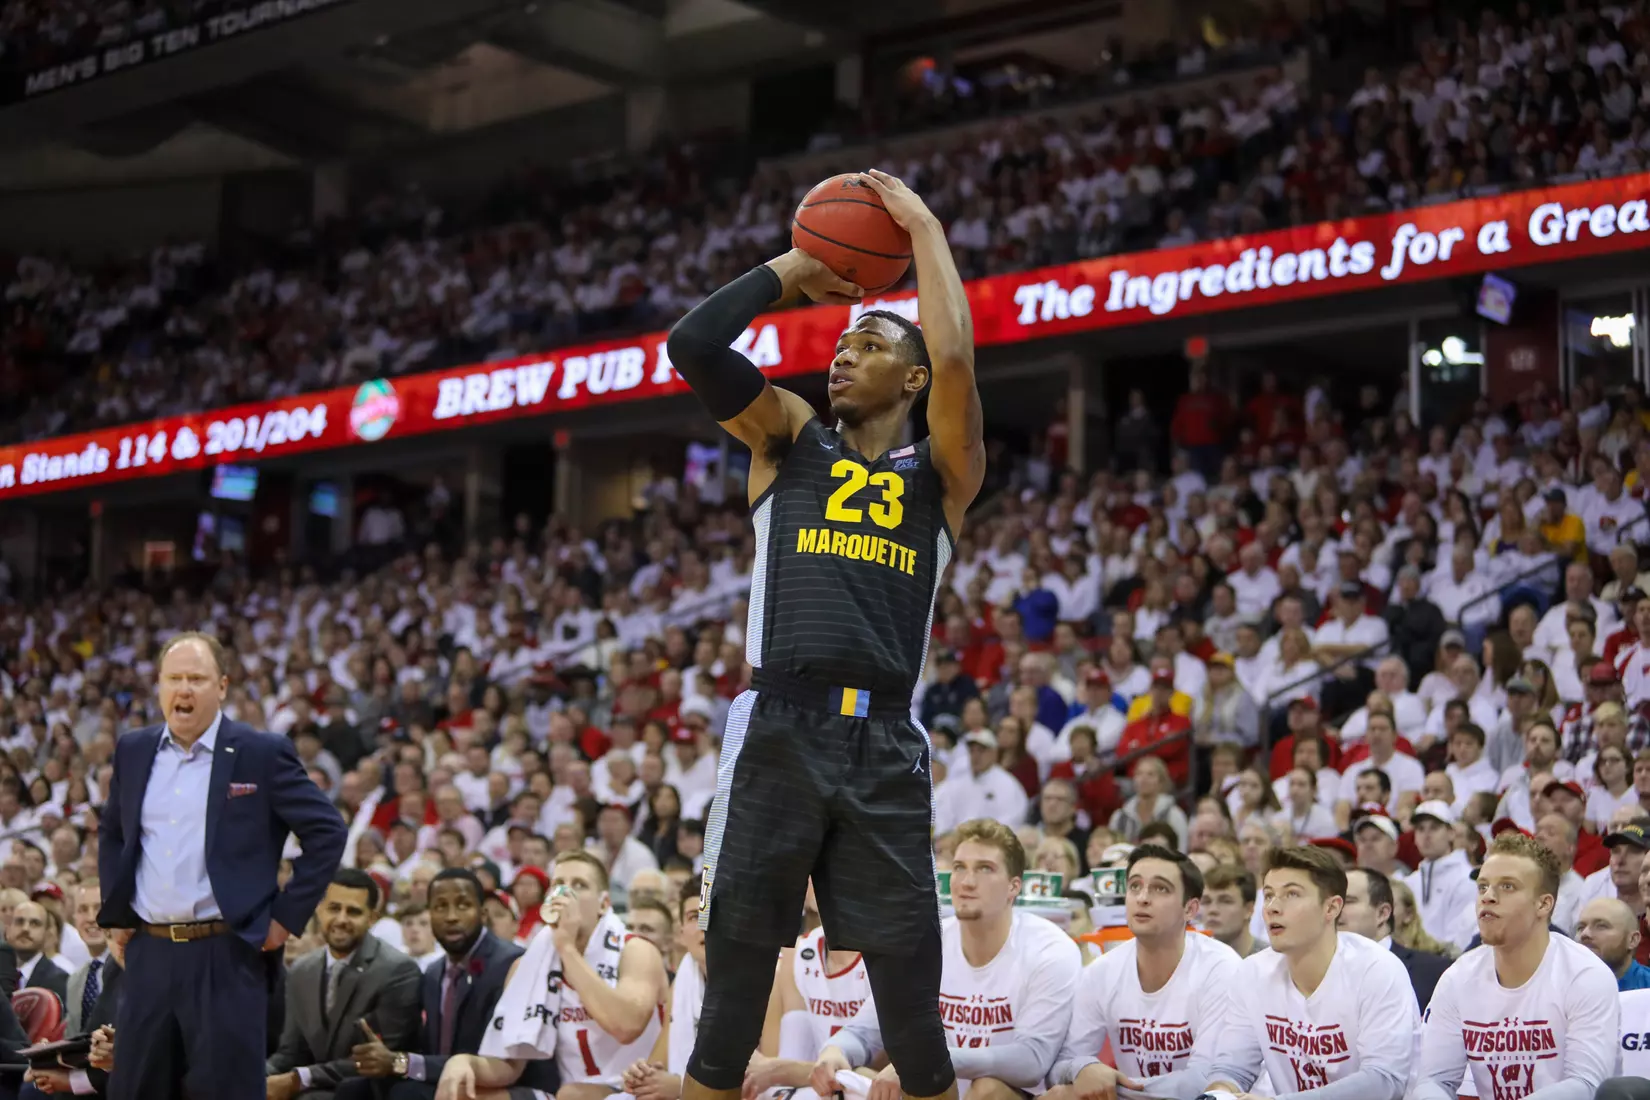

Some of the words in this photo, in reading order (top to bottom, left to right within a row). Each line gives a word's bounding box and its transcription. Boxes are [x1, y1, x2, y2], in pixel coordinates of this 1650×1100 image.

[25, 56, 97, 96] MEN'S
[104, 42, 144, 71] BIG
[152, 25, 200, 56] TEN
[1014, 280, 1095, 325] The
[1105, 237, 1375, 315] Ingredients
[1381, 223, 1464, 280] for
[1477, 221, 1511, 254] a
[1529, 199, 1650, 246] Grea
[433, 362, 555, 419] BREW
[558, 347, 645, 399] PUB
[20, 442, 109, 485] Stands
[117, 431, 167, 469] 114
[171, 426, 200, 460] &
[205, 403, 327, 455] 201/204
[825, 459, 904, 530] 23
[796, 528, 917, 576] MARQUETTE
[576, 1028, 601, 1077] 1
